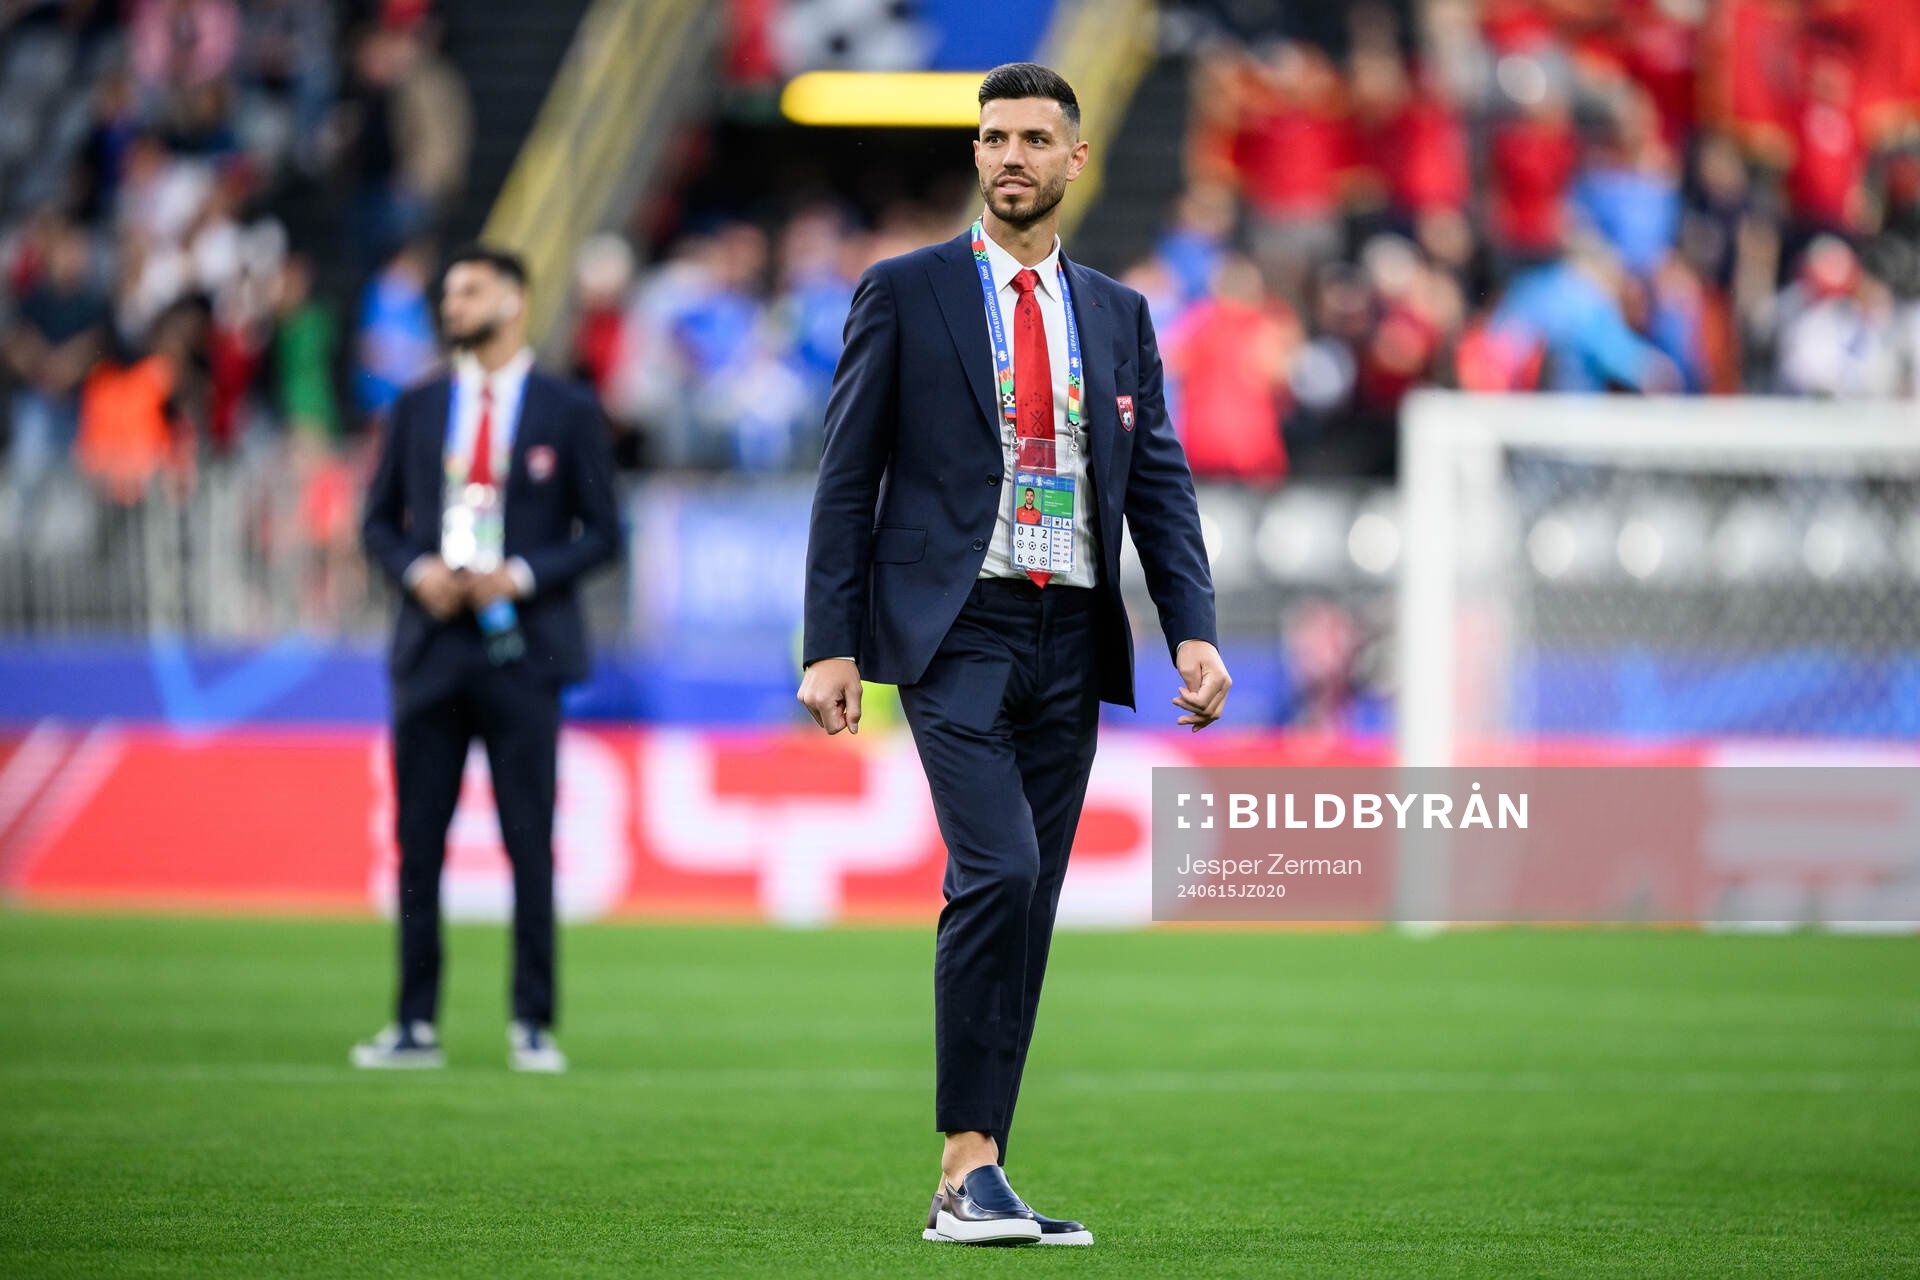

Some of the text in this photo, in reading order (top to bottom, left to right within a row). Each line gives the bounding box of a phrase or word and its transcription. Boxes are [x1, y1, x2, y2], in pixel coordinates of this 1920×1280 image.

[1018, 526, 1048, 539] 0 1 2
[1017, 554, 1023, 563] 6
